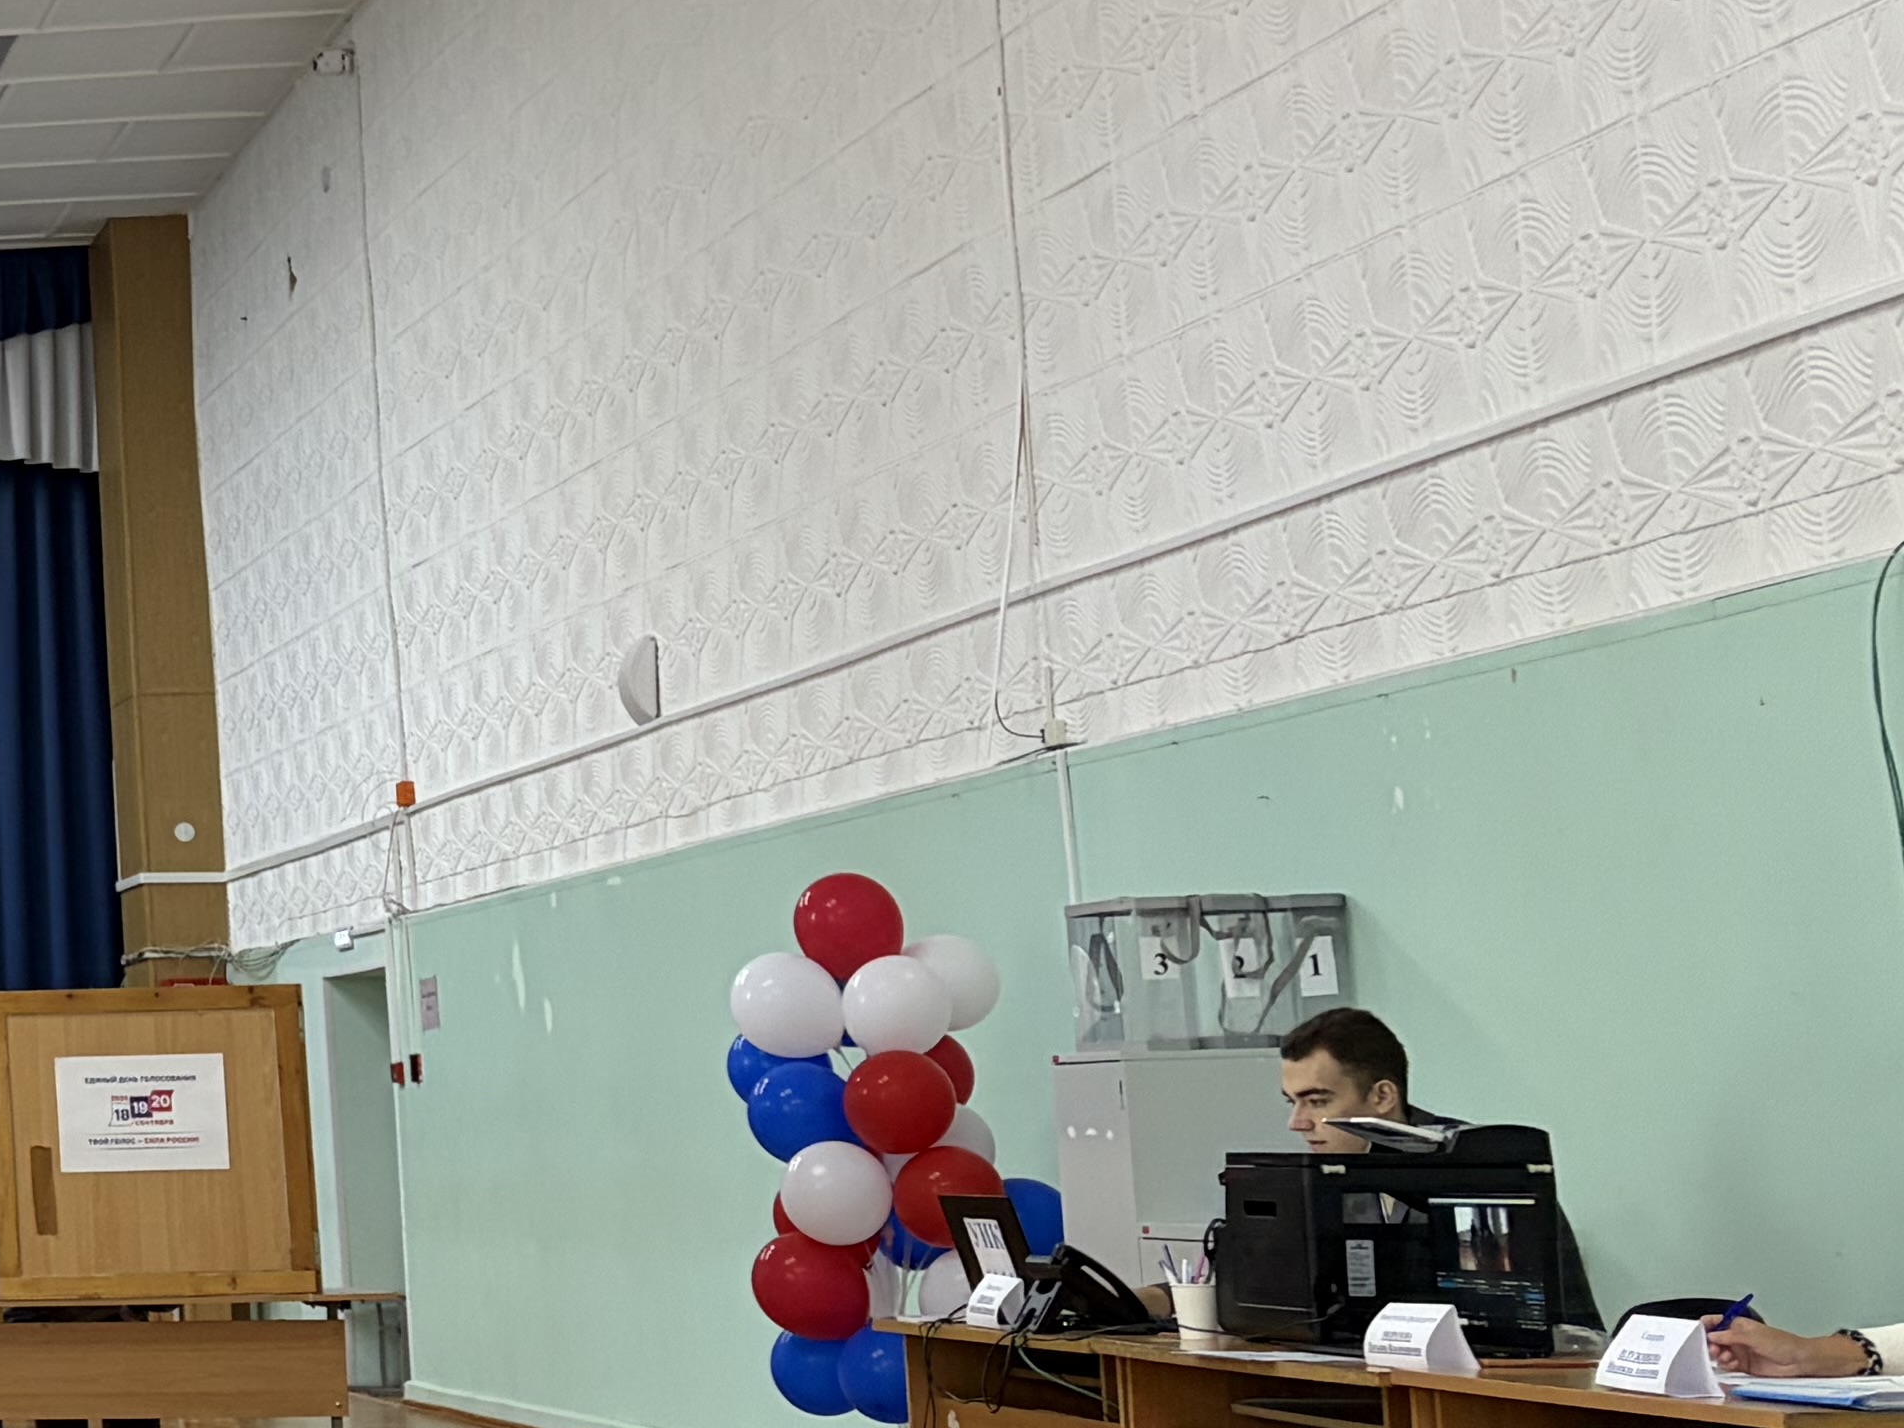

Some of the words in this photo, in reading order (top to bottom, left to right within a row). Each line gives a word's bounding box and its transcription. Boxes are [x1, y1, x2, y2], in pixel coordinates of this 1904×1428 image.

[1154, 952, 1169, 976] 3
[1310, 953, 1321, 976] 1
[115, 1109, 129, 1121] 18
[133, 1102, 148, 1114] 19
[152, 1094, 171, 1108] 20
